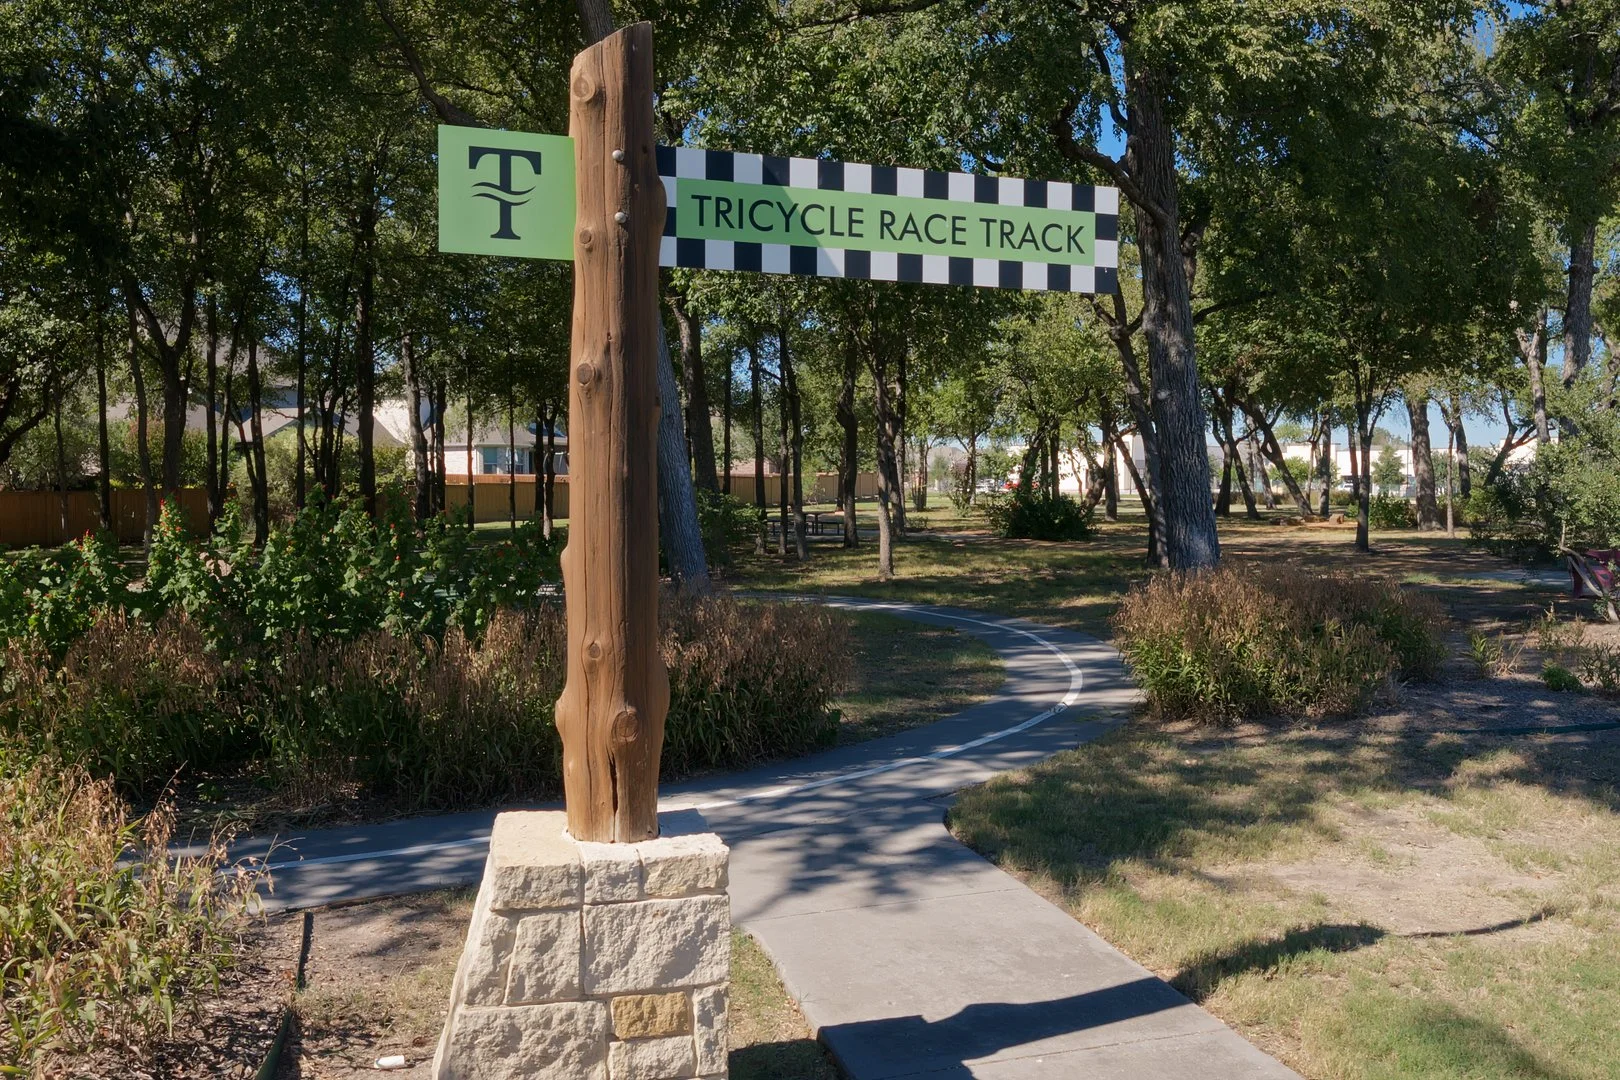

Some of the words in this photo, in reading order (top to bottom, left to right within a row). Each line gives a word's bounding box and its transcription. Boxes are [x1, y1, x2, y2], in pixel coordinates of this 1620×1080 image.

[468, 146, 542, 240] T
[690, 194, 865, 238] TRICYCLE
[879, 209, 968, 246] RACE
[980, 217, 1086, 254] TRACK
